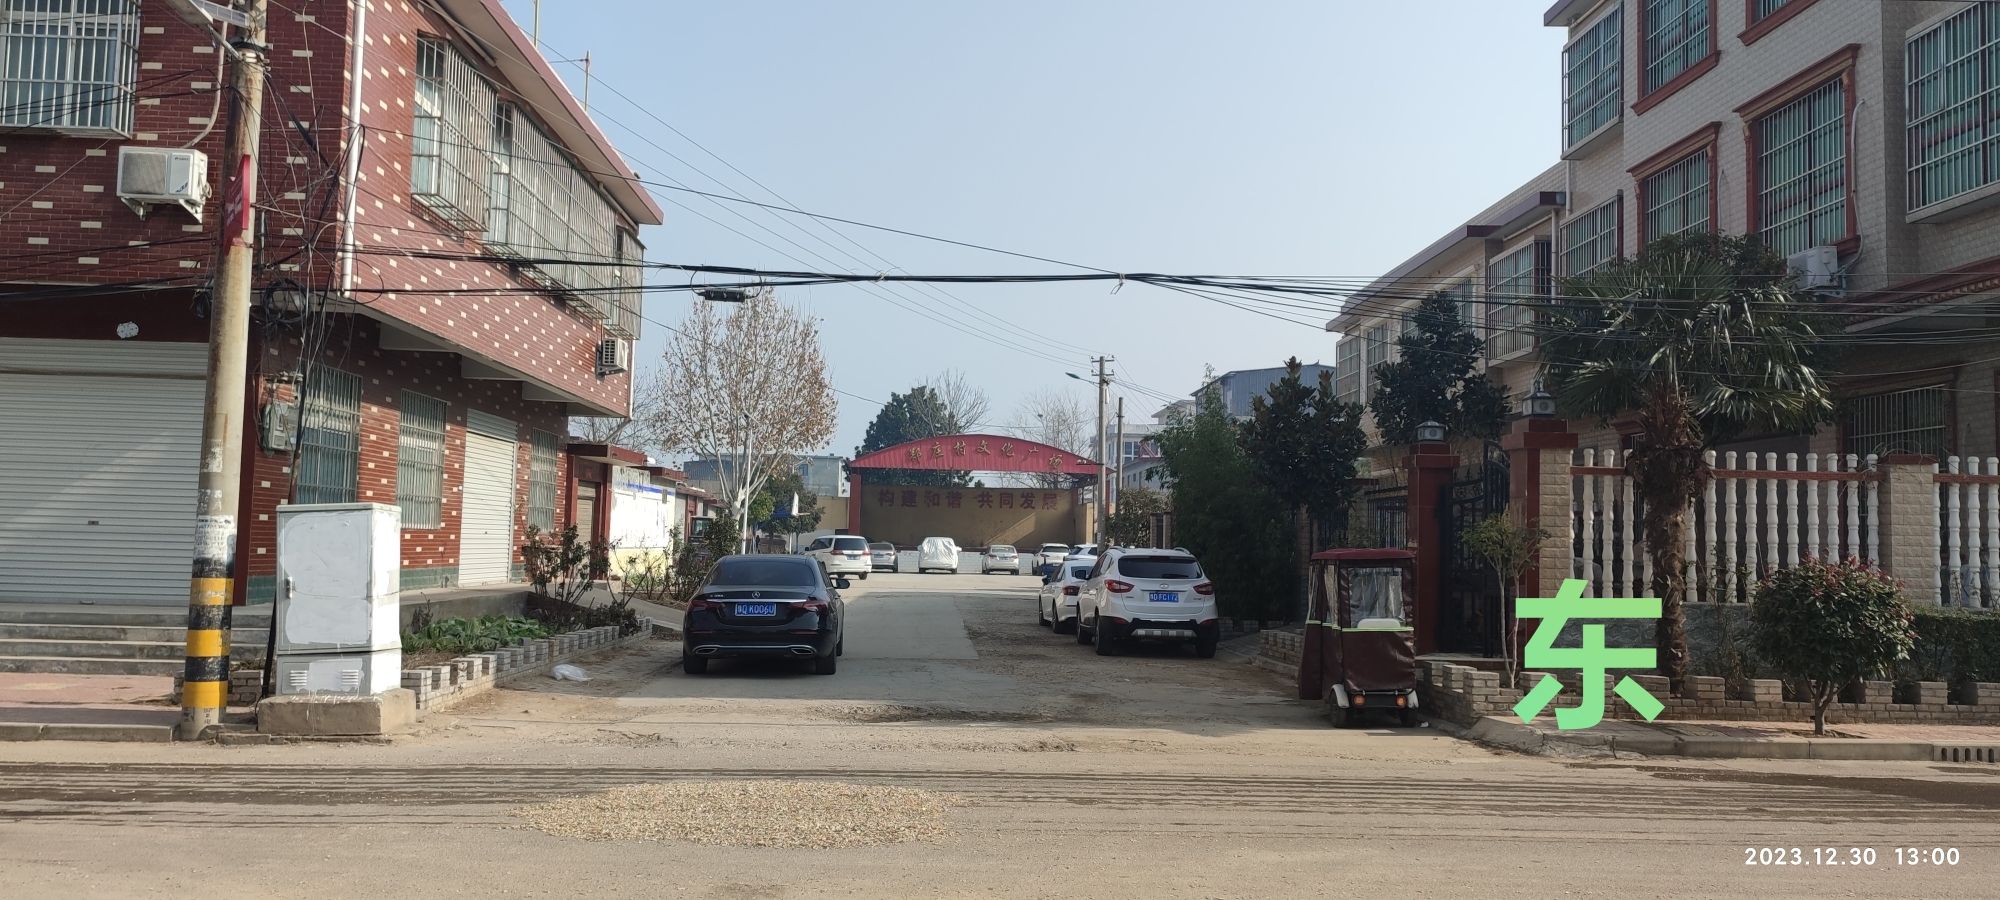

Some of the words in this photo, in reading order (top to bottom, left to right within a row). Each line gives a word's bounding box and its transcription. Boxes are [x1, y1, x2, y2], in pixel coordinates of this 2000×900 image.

[878, 489, 962, 509] 构建和谐
[977, 490, 1058, 511] 共同发展
